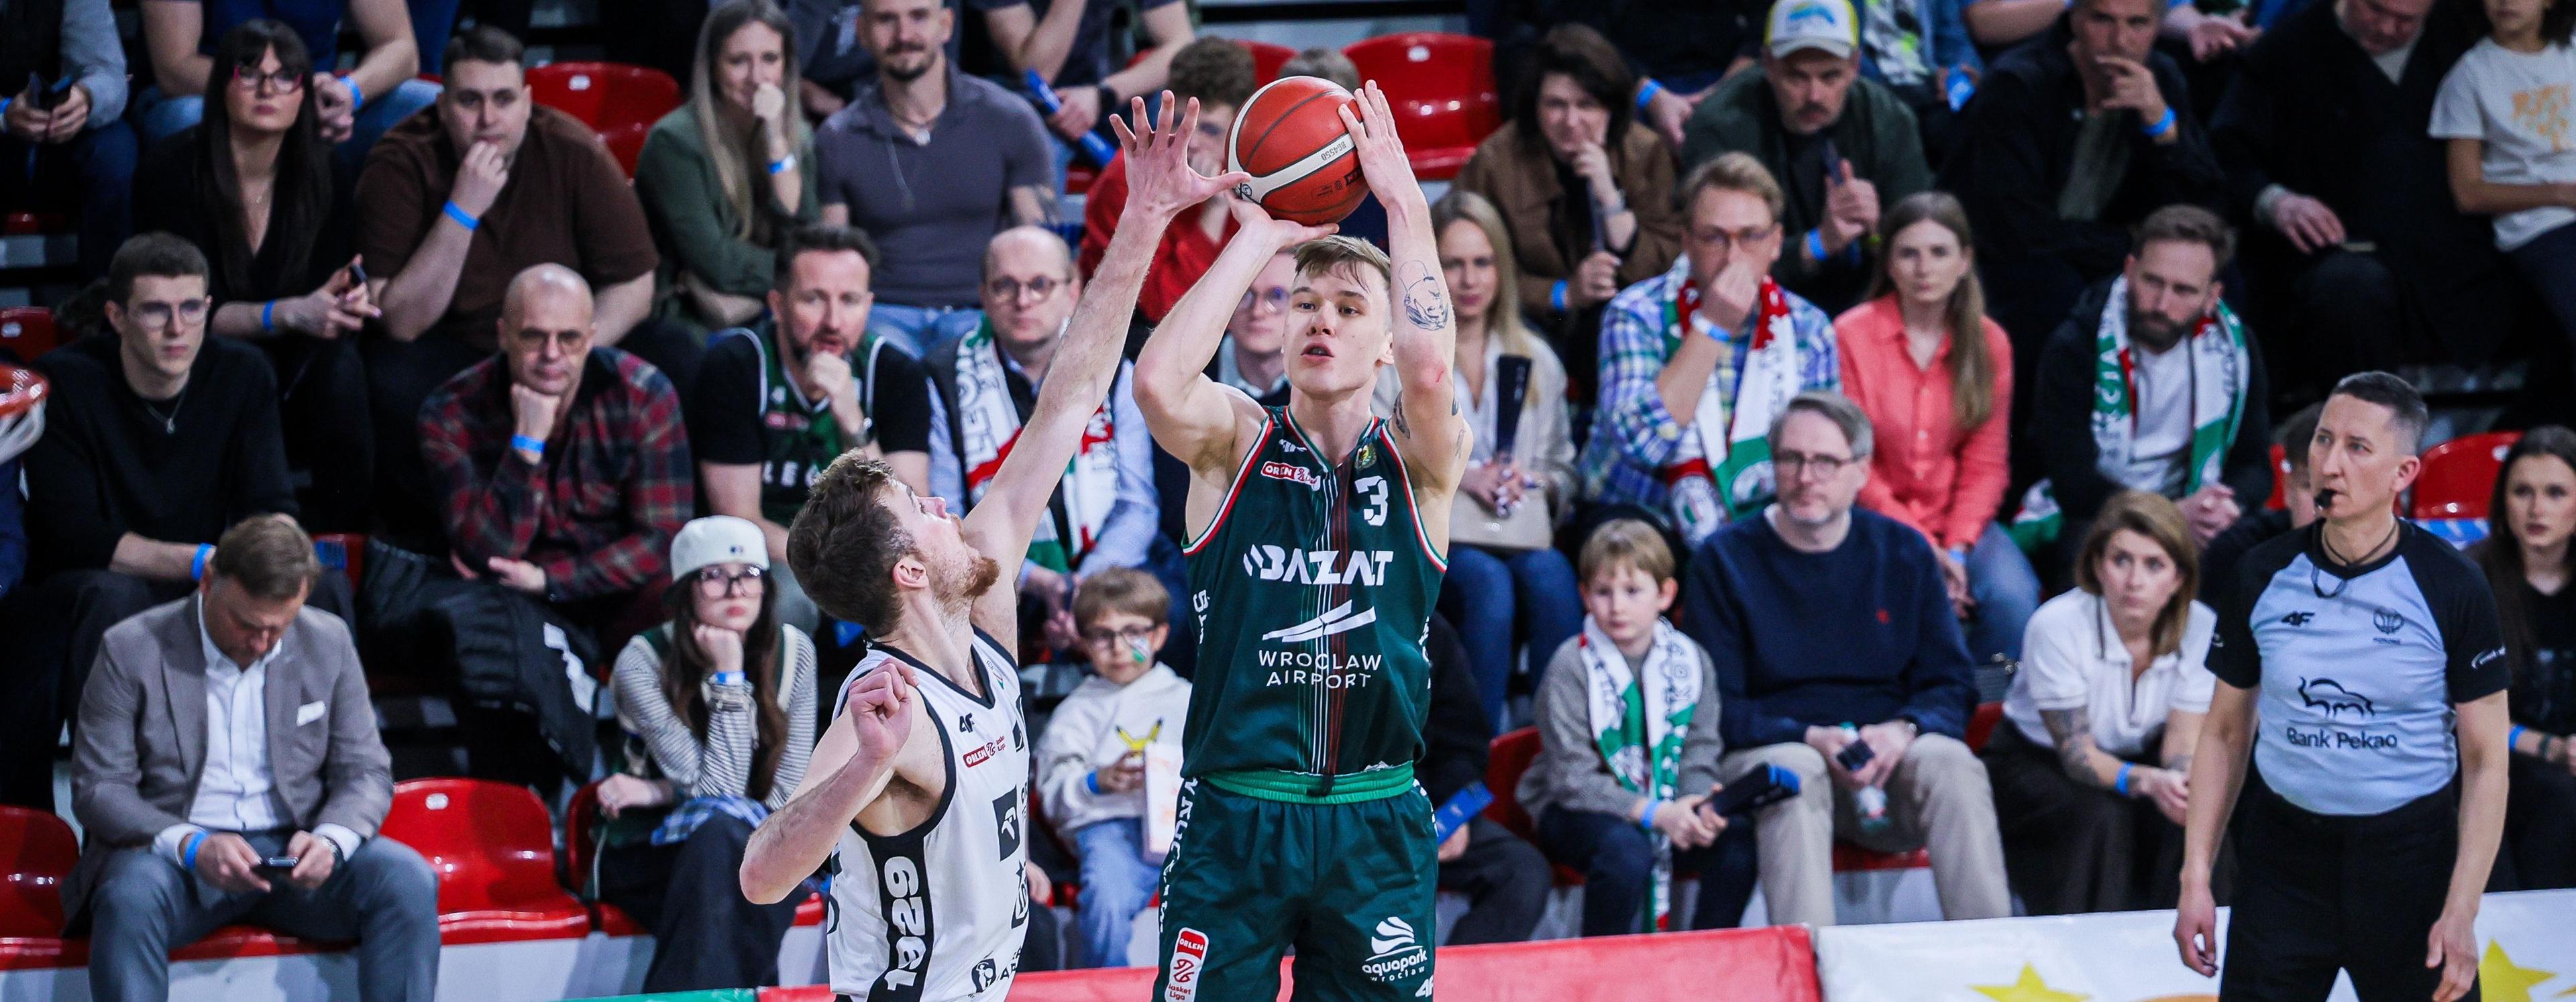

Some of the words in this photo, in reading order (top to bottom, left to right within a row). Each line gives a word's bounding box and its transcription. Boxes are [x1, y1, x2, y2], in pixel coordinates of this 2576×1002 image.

[1354, 475, 1389, 526] 3
[1258, 649, 1383, 671] WROCLAW
[1266, 669, 1372, 689] AIRPORT
[2286, 726, 2330, 748] Bank
[2337, 729, 2398, 750] Pekao
[883, 856, 926, 991] 1929
[1179, 938, 1204, 952] ORLEN
[1361, 948, 1428, 977] aquapark
